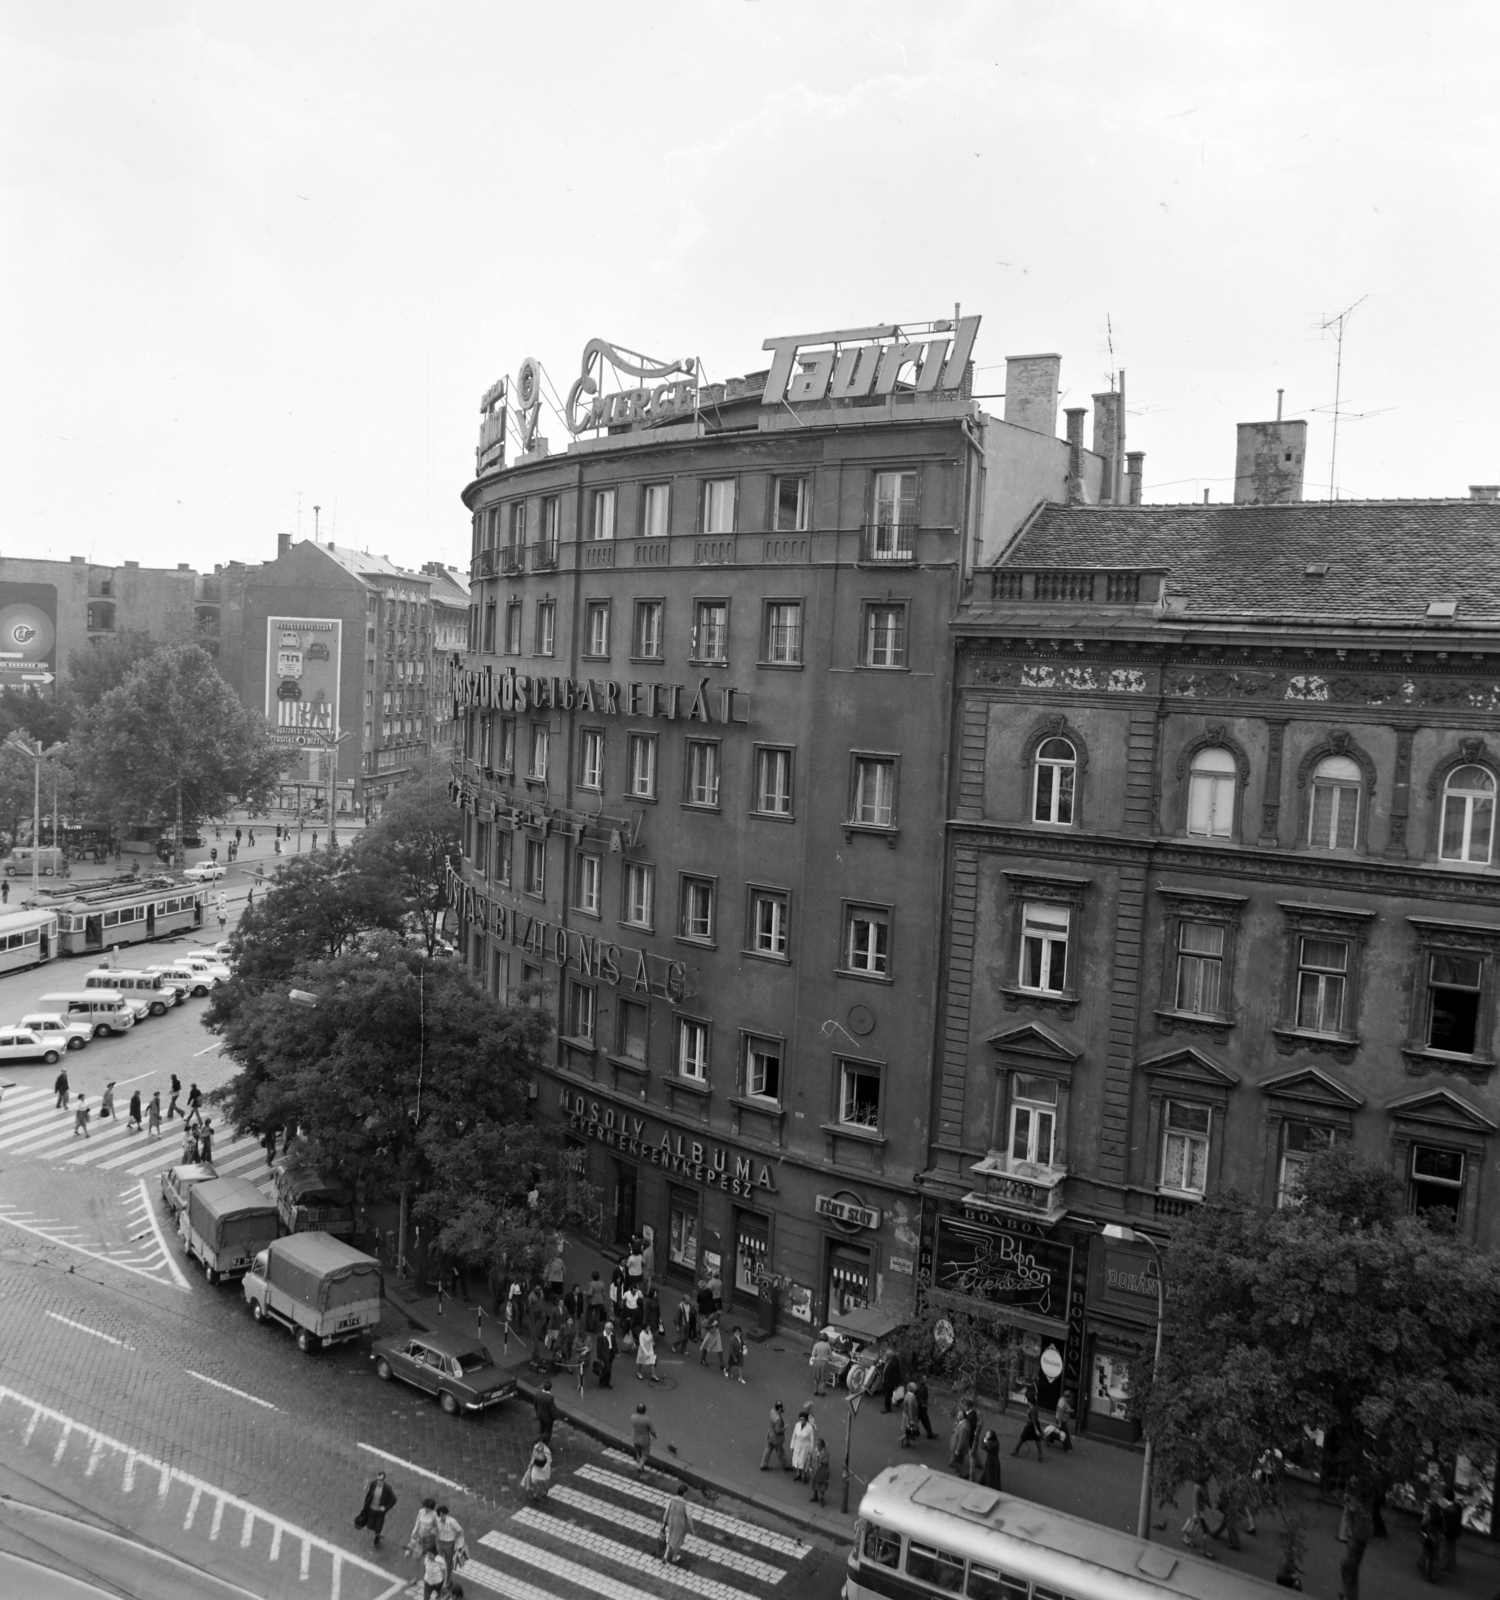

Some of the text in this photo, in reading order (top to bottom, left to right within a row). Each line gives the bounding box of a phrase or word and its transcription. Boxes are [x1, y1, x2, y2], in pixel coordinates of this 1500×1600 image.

[762, 314, 982, 405] Tauril
[558, 1088, 773, 1189] MOSOLY ALBUMA
[964, 1209, 1047, 1238] BONBON
[1067, 1291, 1084, 1377] BONBON
